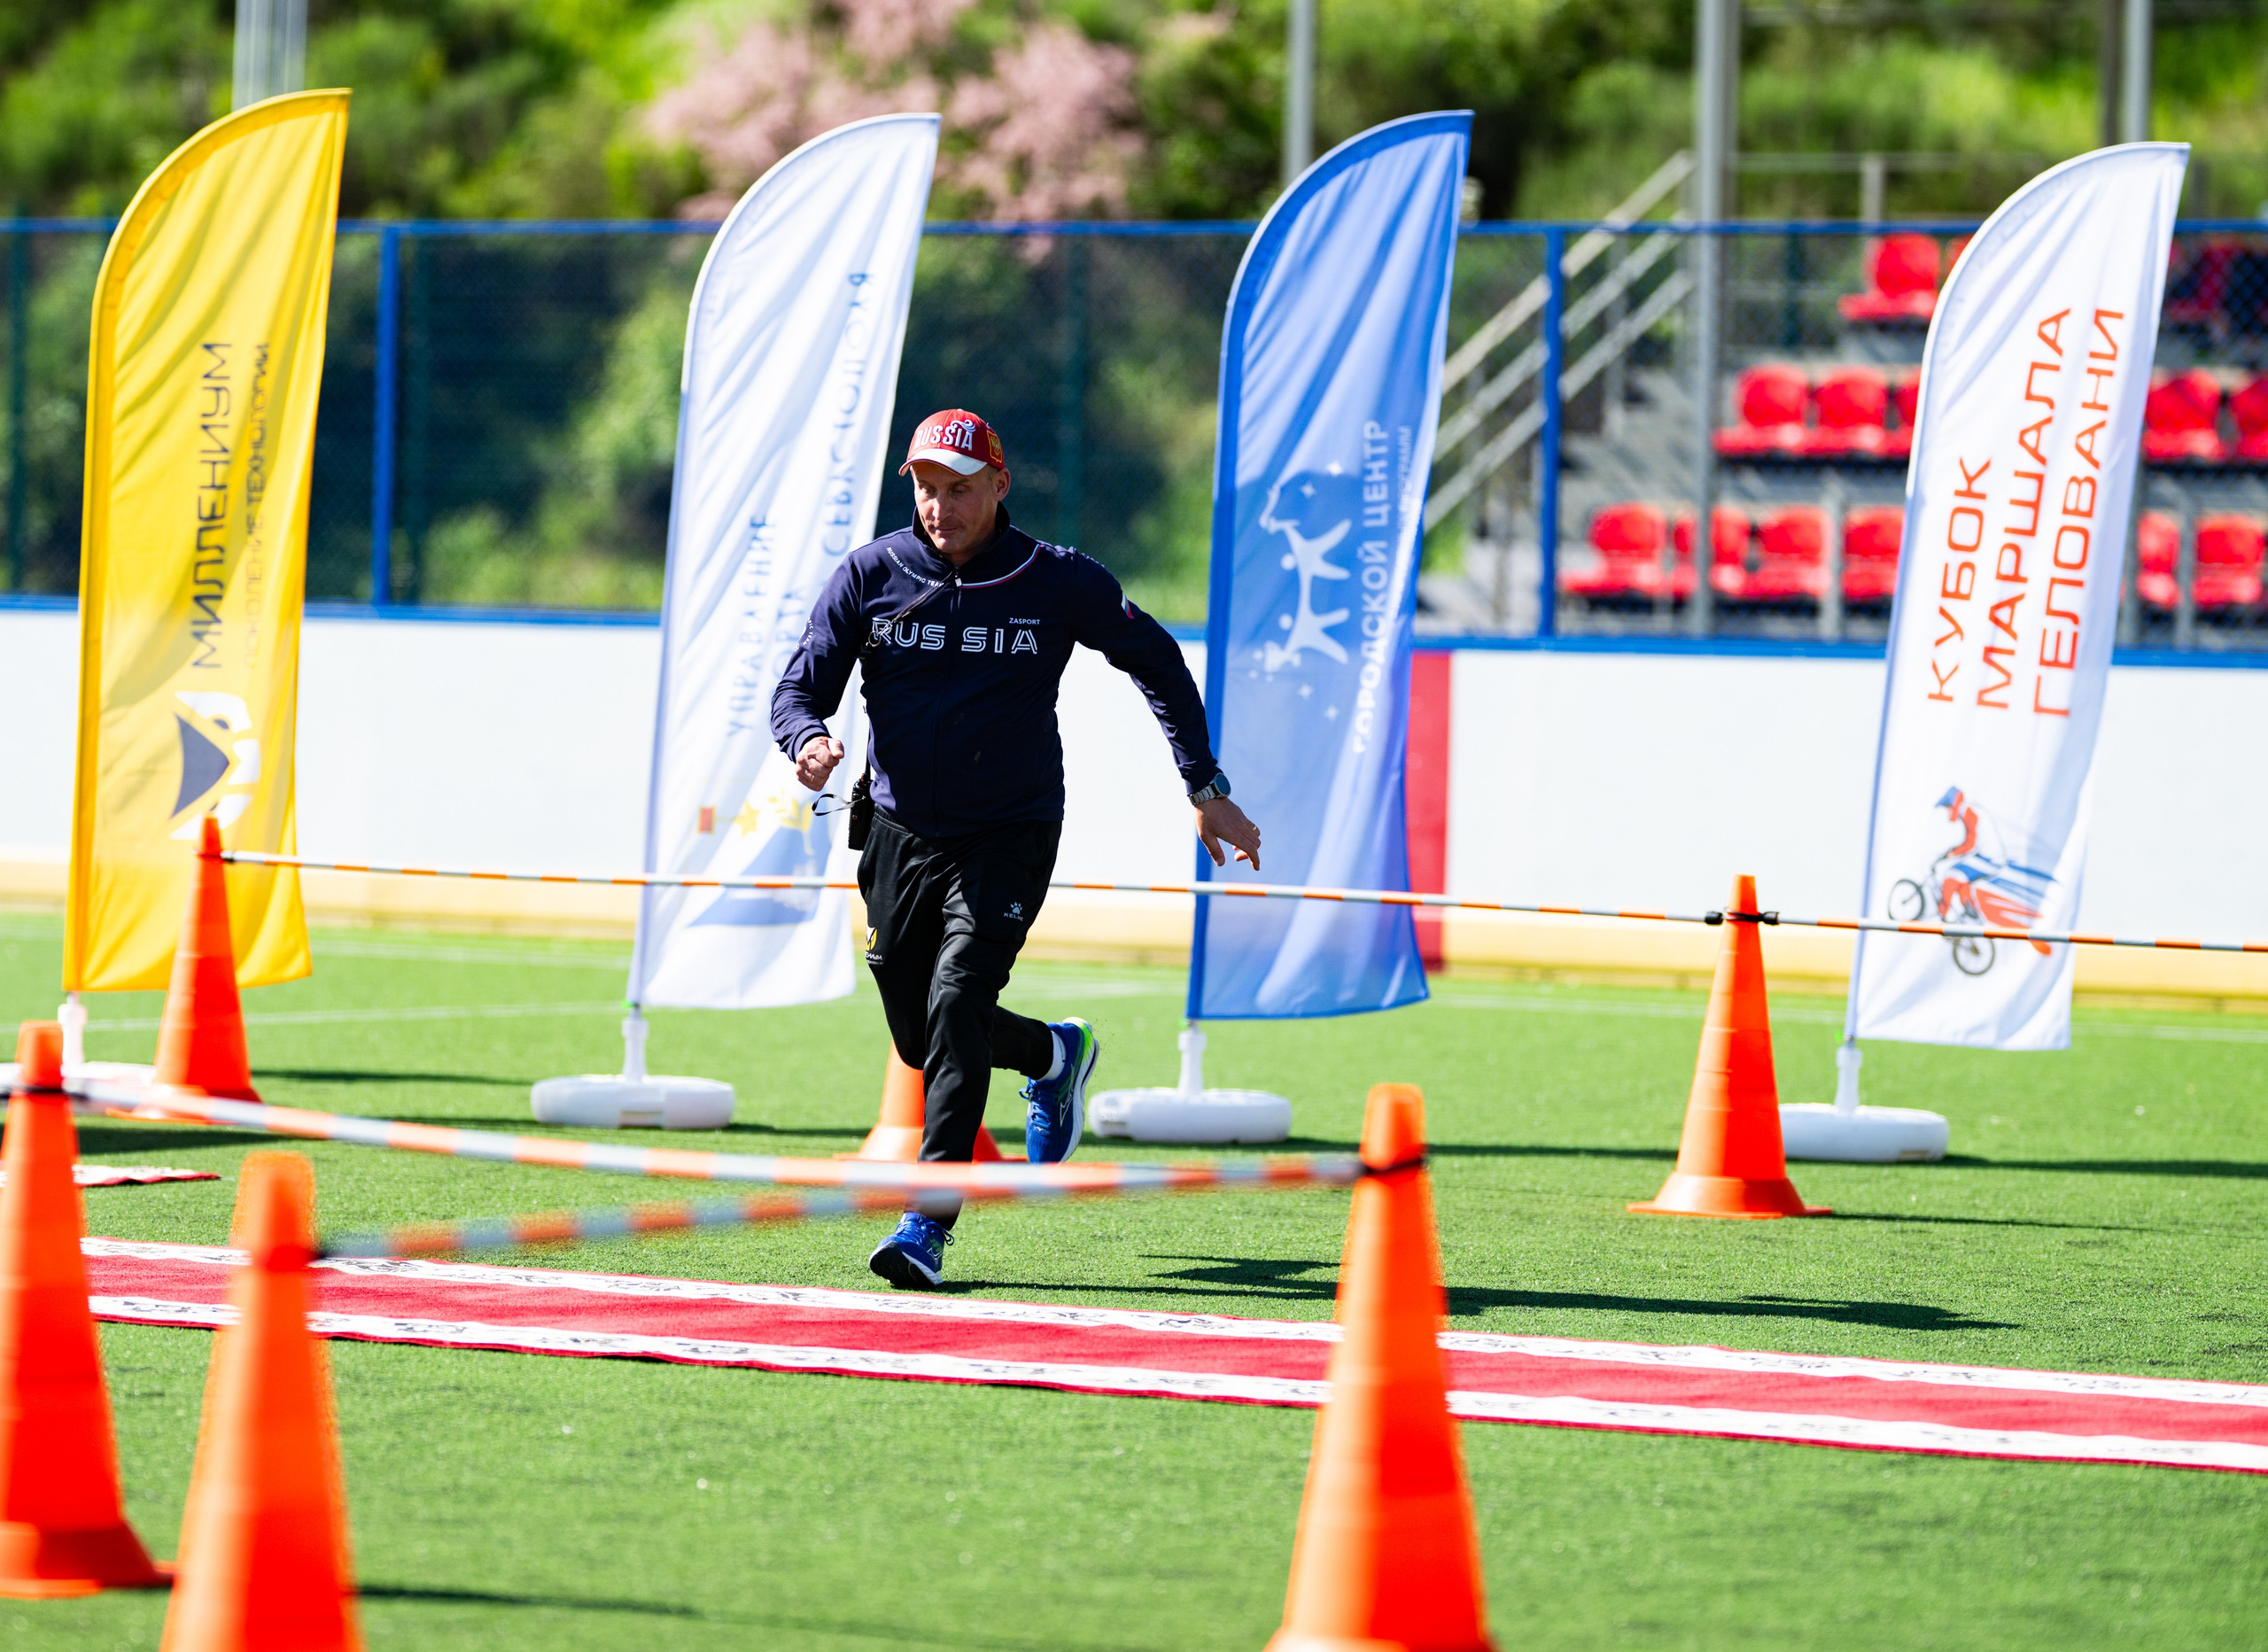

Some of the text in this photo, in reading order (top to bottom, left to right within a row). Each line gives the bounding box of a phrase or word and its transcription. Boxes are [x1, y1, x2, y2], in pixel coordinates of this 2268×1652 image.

[191, 342, 232, 669] МИЛЛЕНИУМ
[887, 547, 905, 568] RUSSIAN
[902, 566, 927, 584] OLYMPIC
[913, 423, 974, 452] RUSSIA
[1927, 456, 1992, 703] КУБОК
[1977, 307, 2071, 710] МАРШАЛА
[2033, 308, 2124, 717] ГЕЛОВАНИ
[726, 516, 775, 737] УПРАВЛЕНИЕ
[1353, 419, 1391, 754] ГОРОДСКОЙ ЦЕНТР
